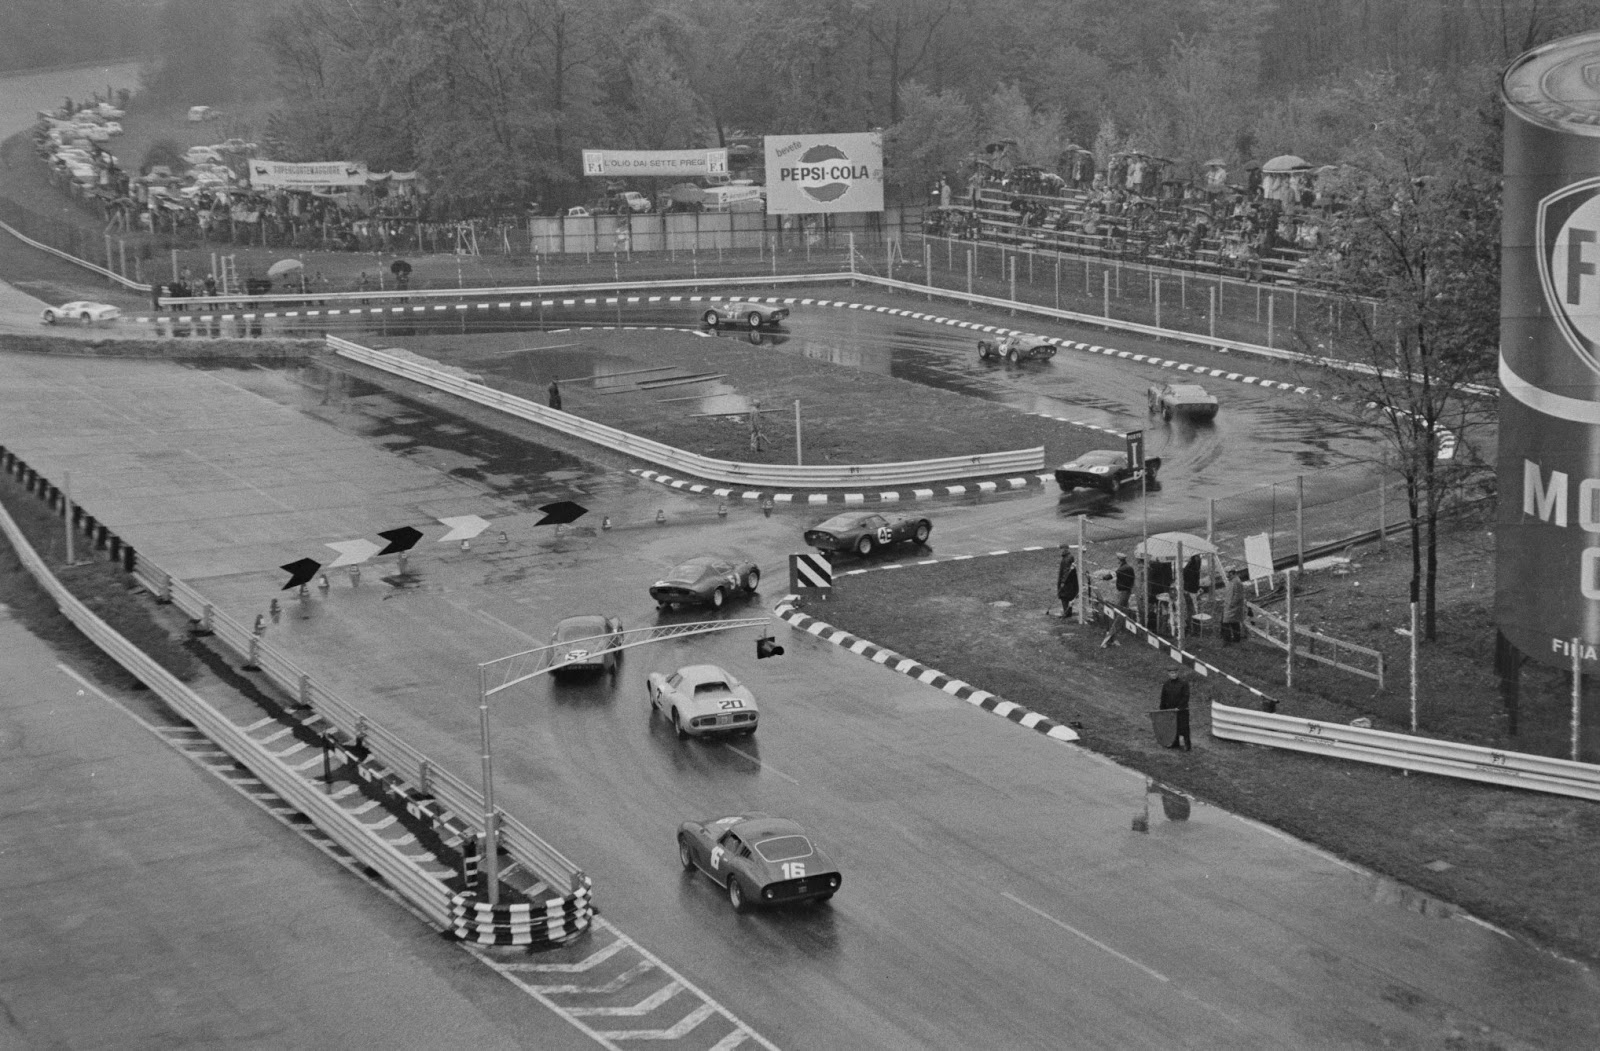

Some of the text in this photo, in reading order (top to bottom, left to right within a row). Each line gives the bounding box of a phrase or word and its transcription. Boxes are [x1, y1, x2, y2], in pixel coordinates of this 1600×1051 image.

[775, 141, 802, 158] bevete
[719, 700, 744, 710] 20
[781, 862, 806, 880] 16
